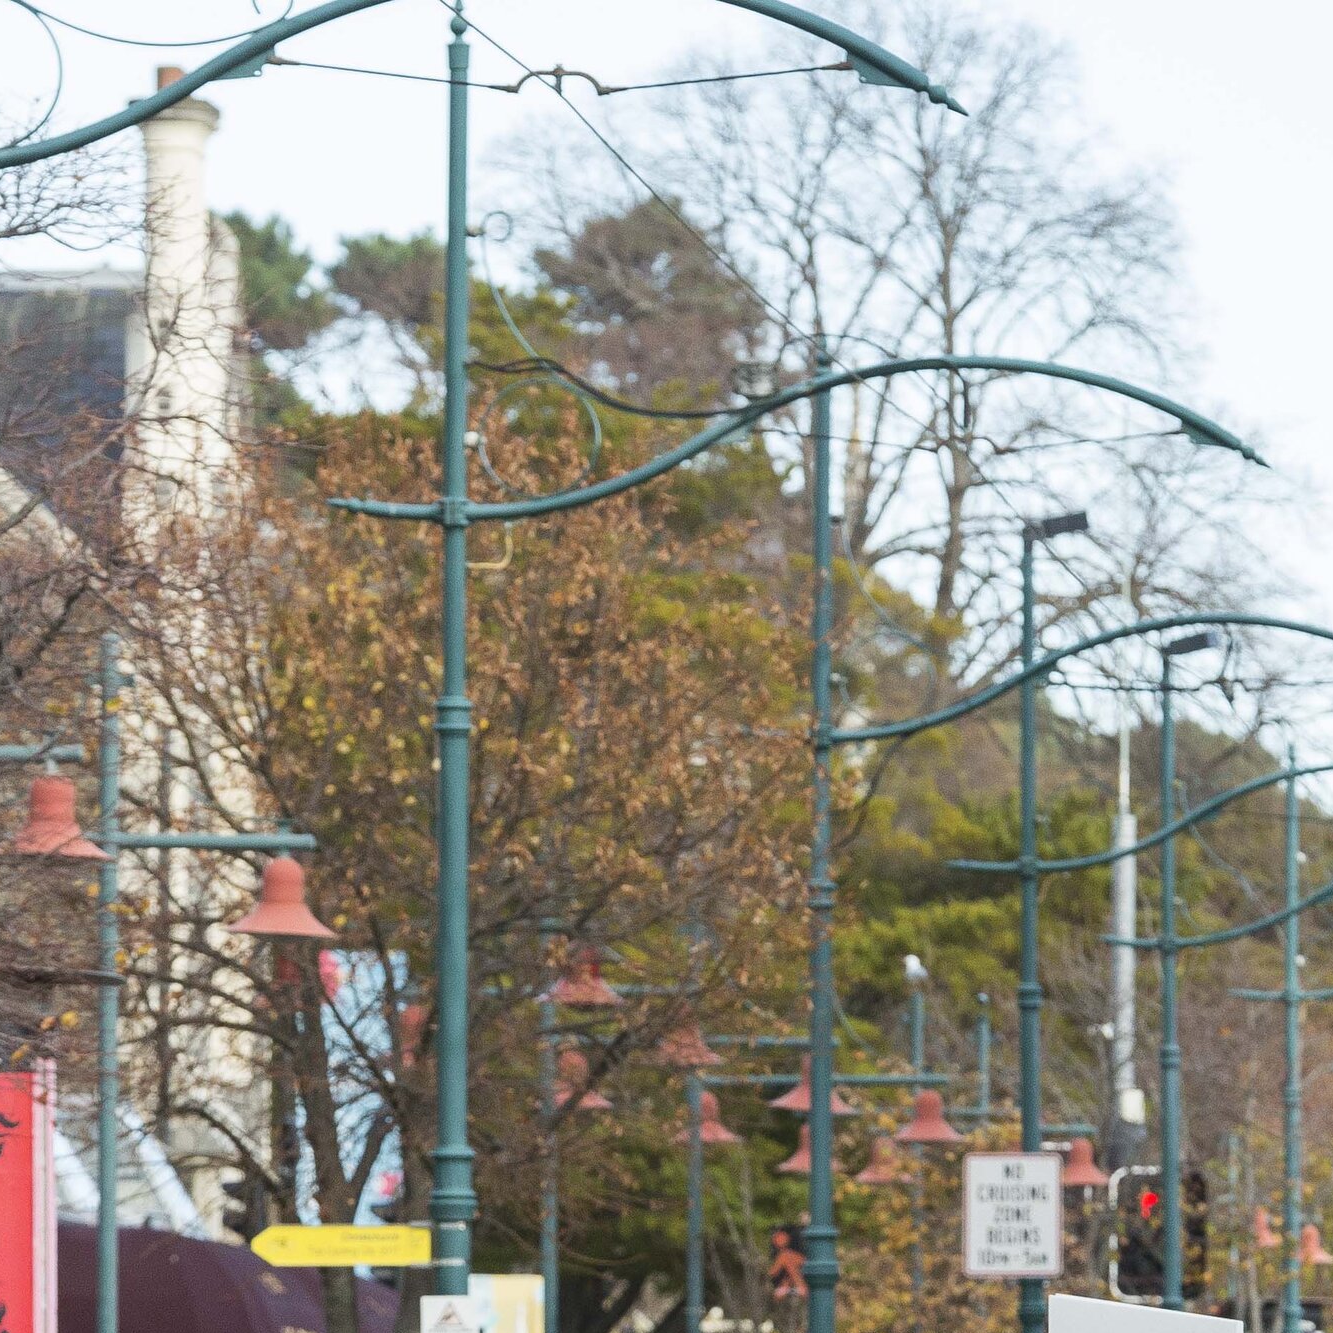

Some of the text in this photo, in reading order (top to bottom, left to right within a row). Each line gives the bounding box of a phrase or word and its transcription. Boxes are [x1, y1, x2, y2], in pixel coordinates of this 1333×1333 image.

[1003, 1162, 1025, 1179] NO
[977, 1183, 1049, 1202] CRUISING
[995, 1205, 1031, 1222] ZONE
